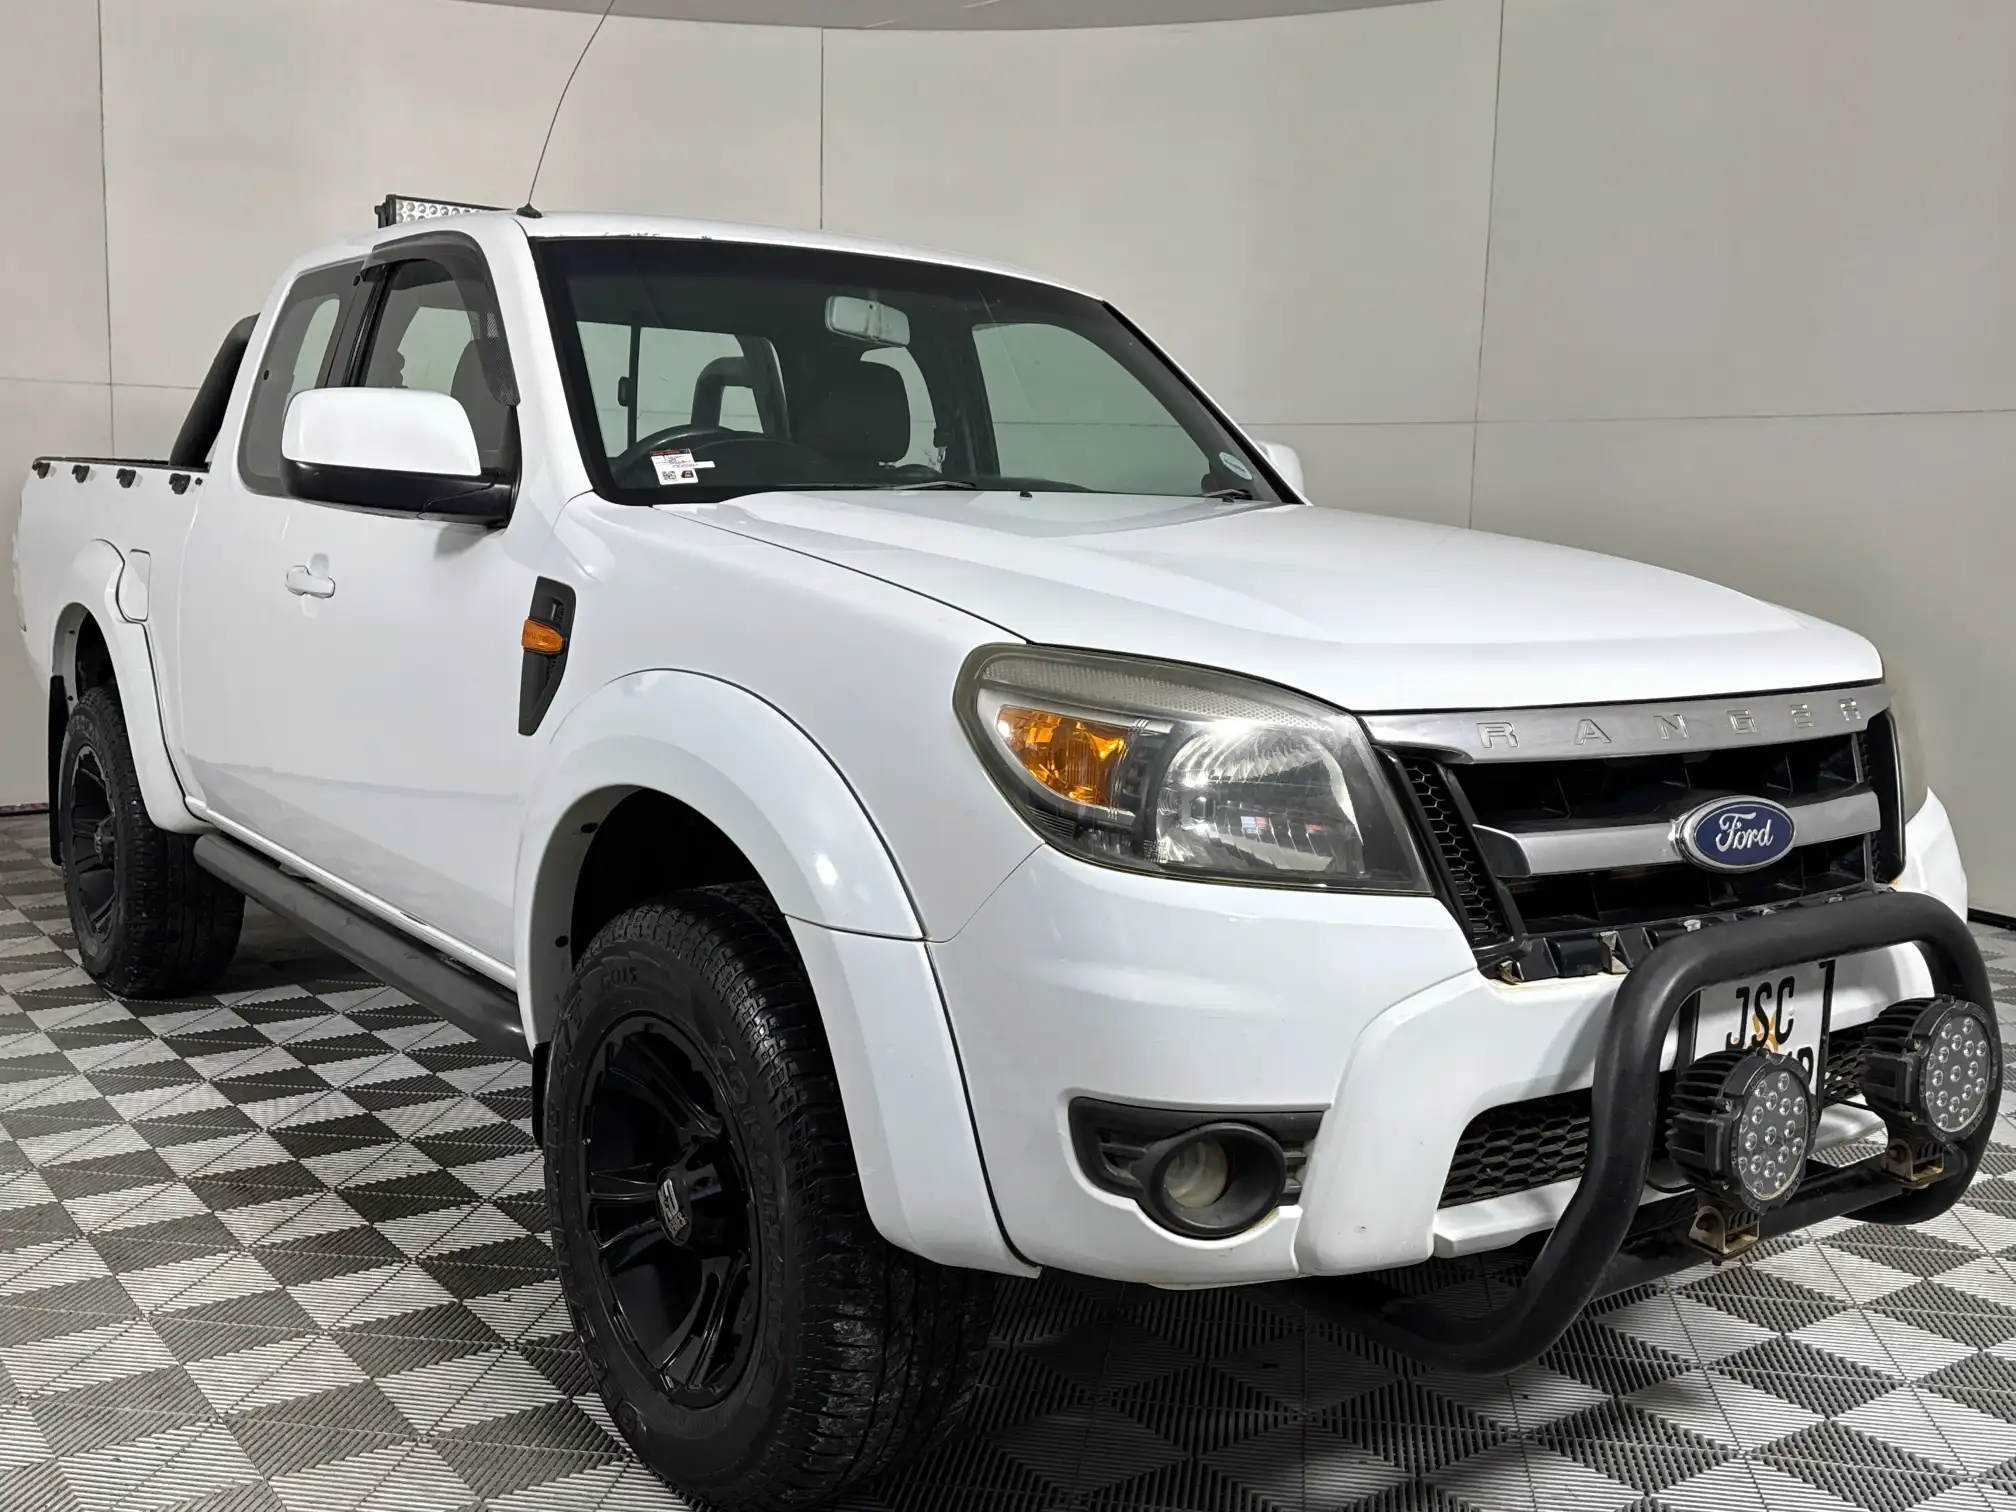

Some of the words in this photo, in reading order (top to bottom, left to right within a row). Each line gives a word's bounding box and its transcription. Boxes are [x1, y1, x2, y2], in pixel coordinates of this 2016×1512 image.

[1476, 698, 1863, 749] RANGER
[1716, 812, 1773, 852] Ford
[1726, 975, 1795, 1050] JSC
